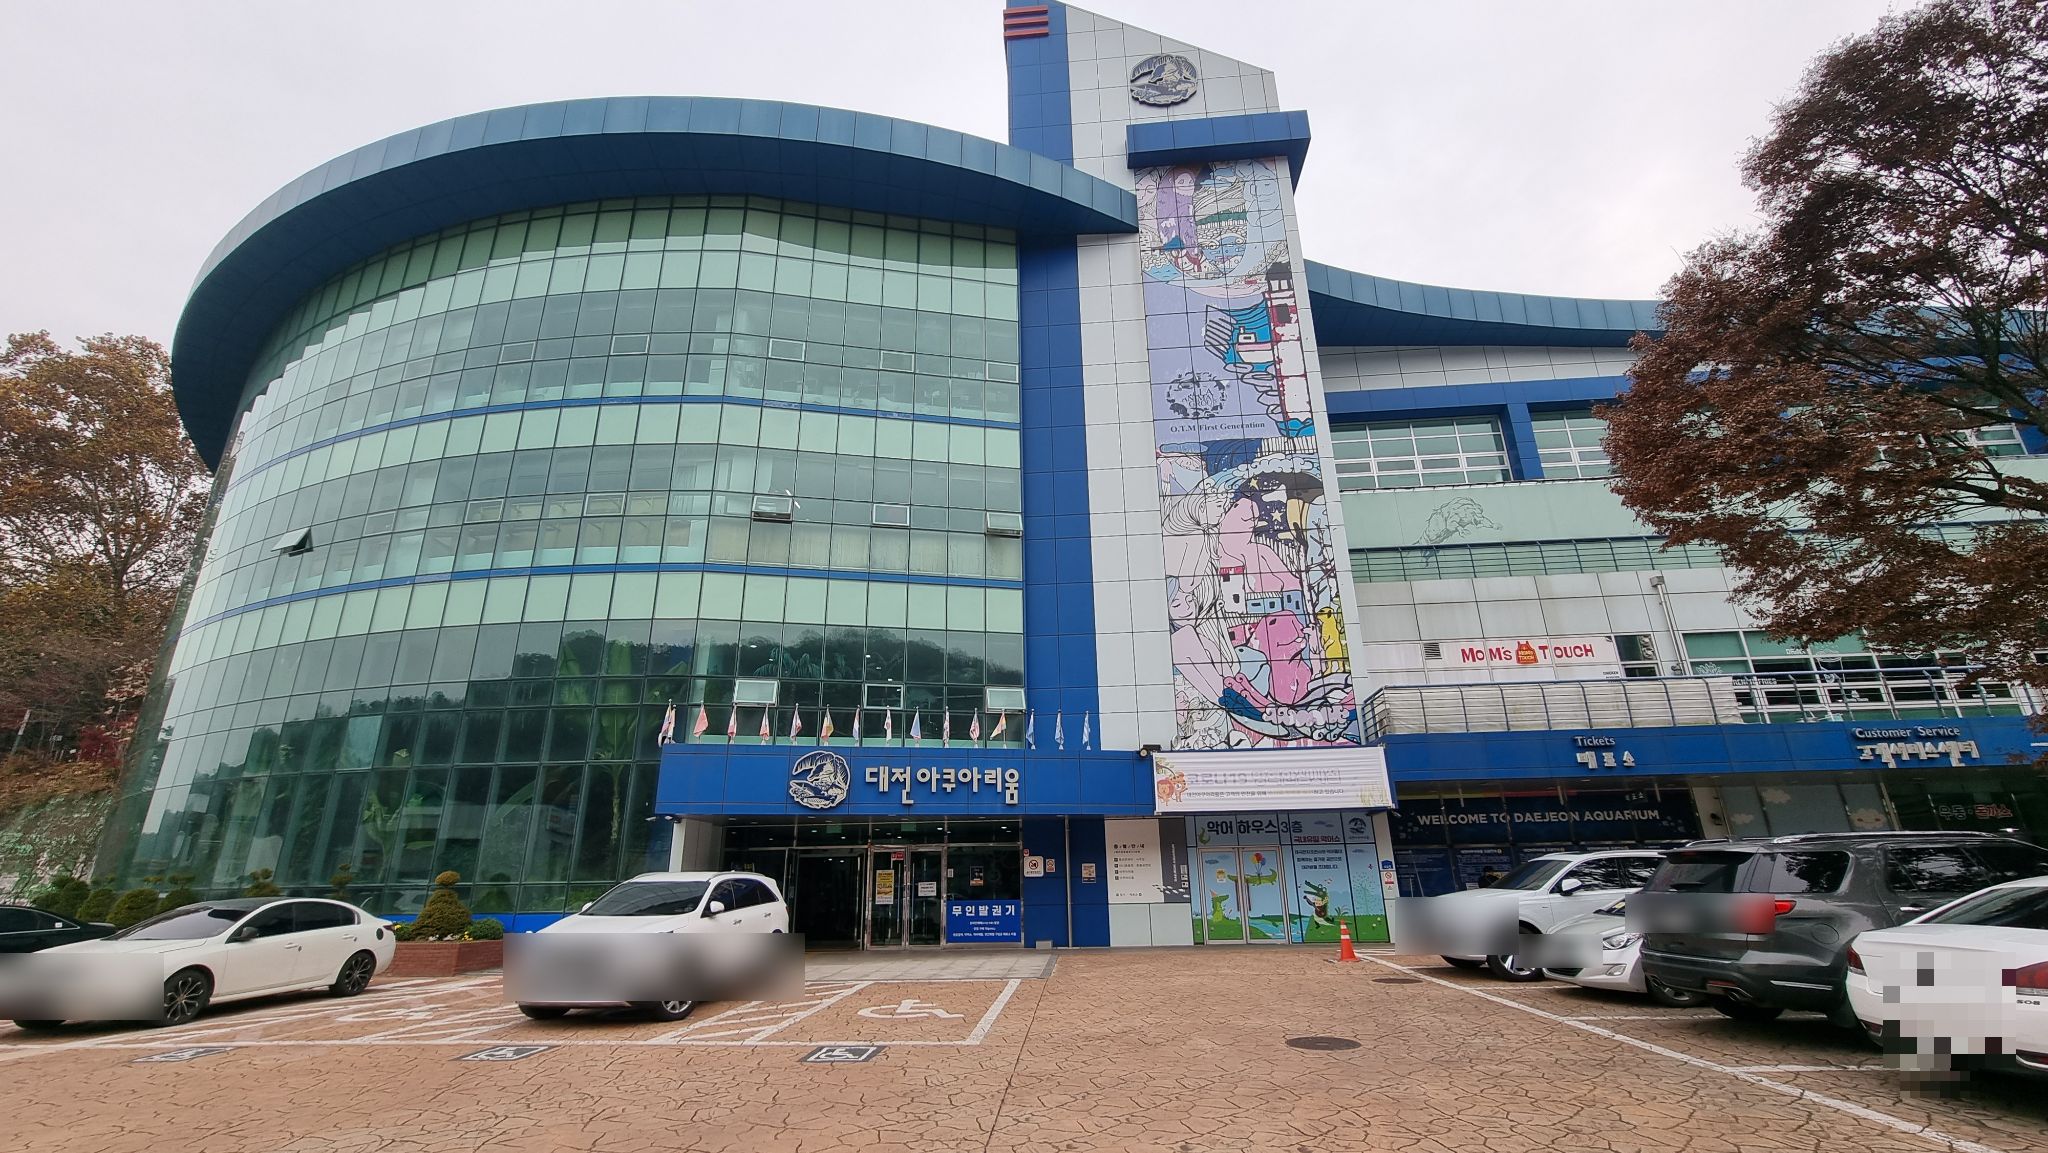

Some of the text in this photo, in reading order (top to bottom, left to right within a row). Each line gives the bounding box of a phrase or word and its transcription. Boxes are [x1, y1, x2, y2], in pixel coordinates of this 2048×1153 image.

[1170, 422, 1265, 433] O.T.M First Generation
[1538, 644, 1595, 661] TOUCH
[1855, 726, 1961, 739] Customer Service
[1575, 736, 1616, 747] Tickets
[1417, 809, 1660, 826] WELCOME TO DAEJEON AQUARIUM
[1207, 821, 1234, 835] 악어
[1238, 820, 1278, 834] 하우스
[952, 905, 1015, 917] 무인발권기
